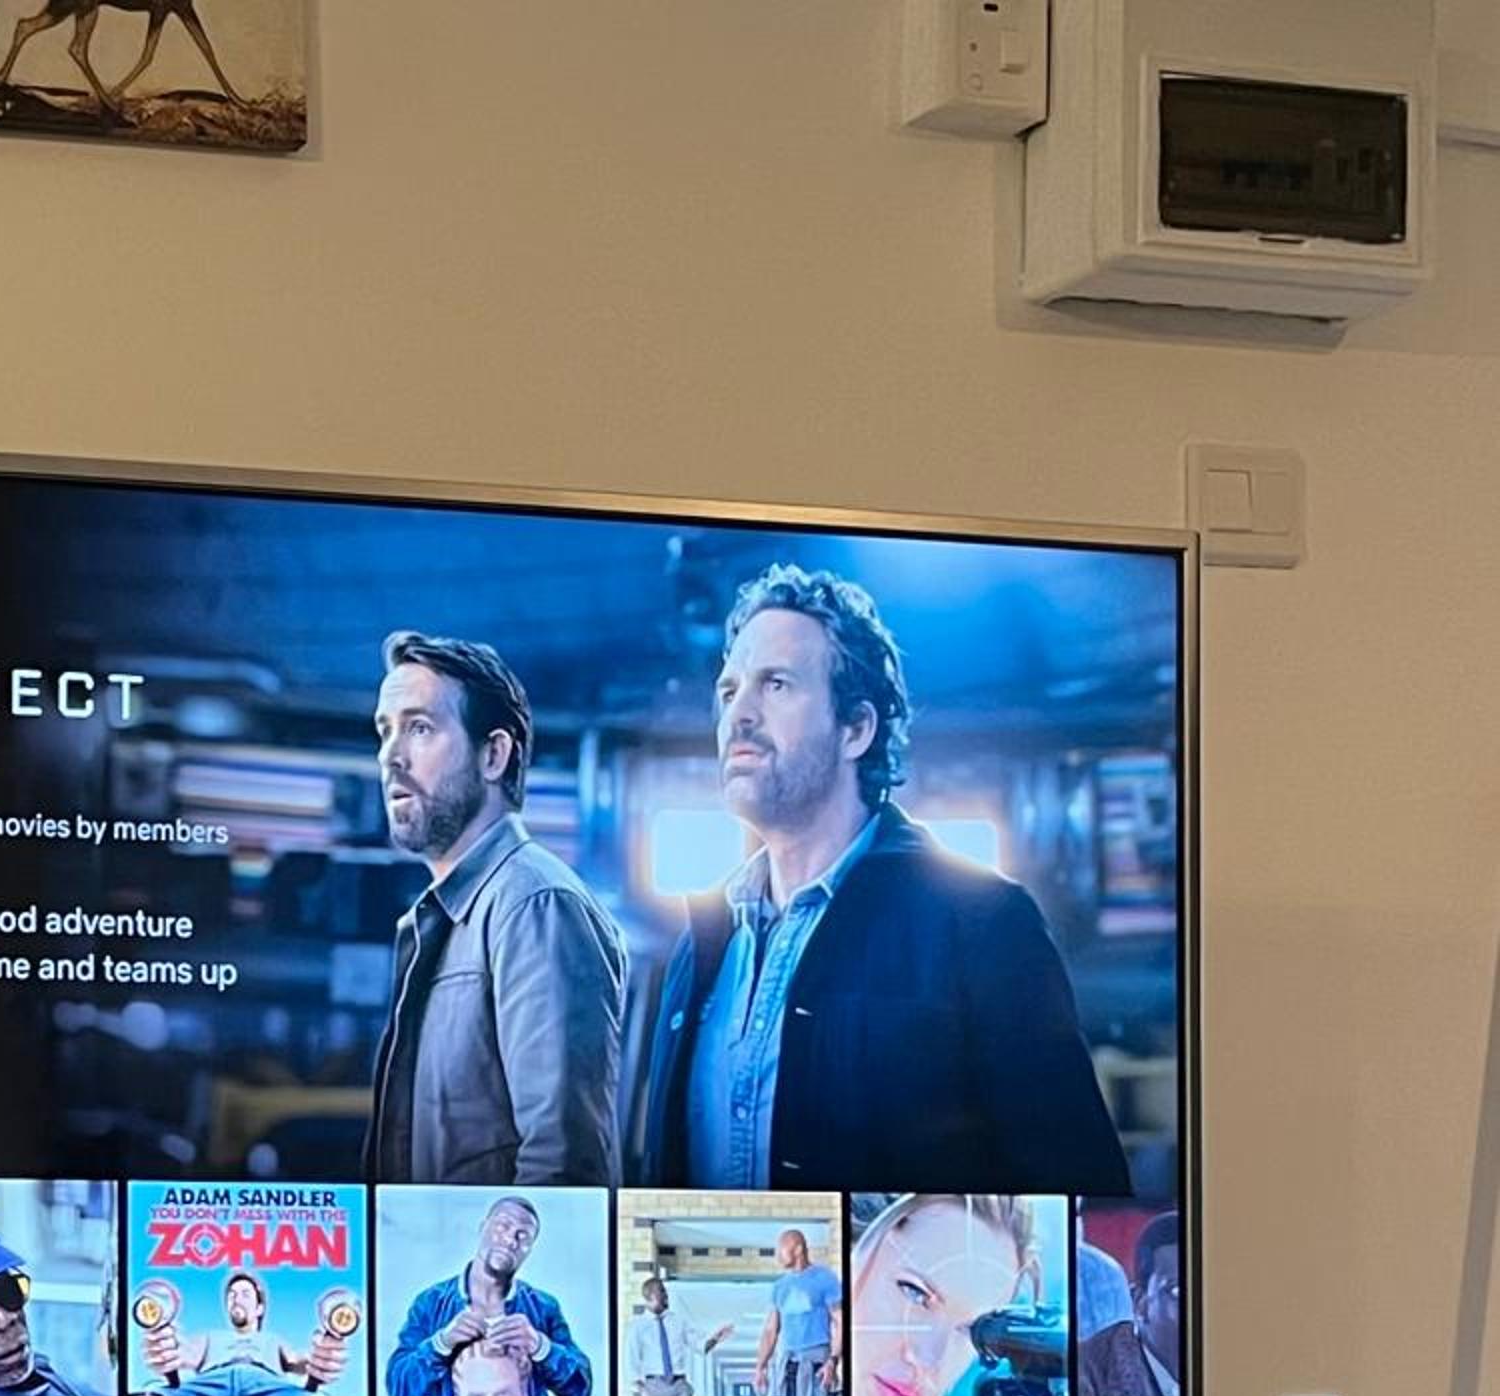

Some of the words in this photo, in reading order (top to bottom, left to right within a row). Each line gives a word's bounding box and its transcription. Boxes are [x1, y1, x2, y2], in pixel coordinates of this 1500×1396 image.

[76, 814, 106, 844] by
[113, 817, 229, 844] members
[45, 908, 193, 938] adventure
[38, 953, 94, 982] and
[102, 955, 193, 985] teams
[201, 961, 237, 992] up
[164, 1188, 231, 1205] ADAM
[238, 1190, 336, 1206] SANDLER
[152, 1207, 180, 1219] YOU
[185, 1208, 230, 1220] DON'T
[235, 1209, 272, 1220] MESS
[277, 1209, 315, 1221] WITH
[319, 1210, 346, 1221] THE
[148, 1222, 347, 1267] ZOHAN
